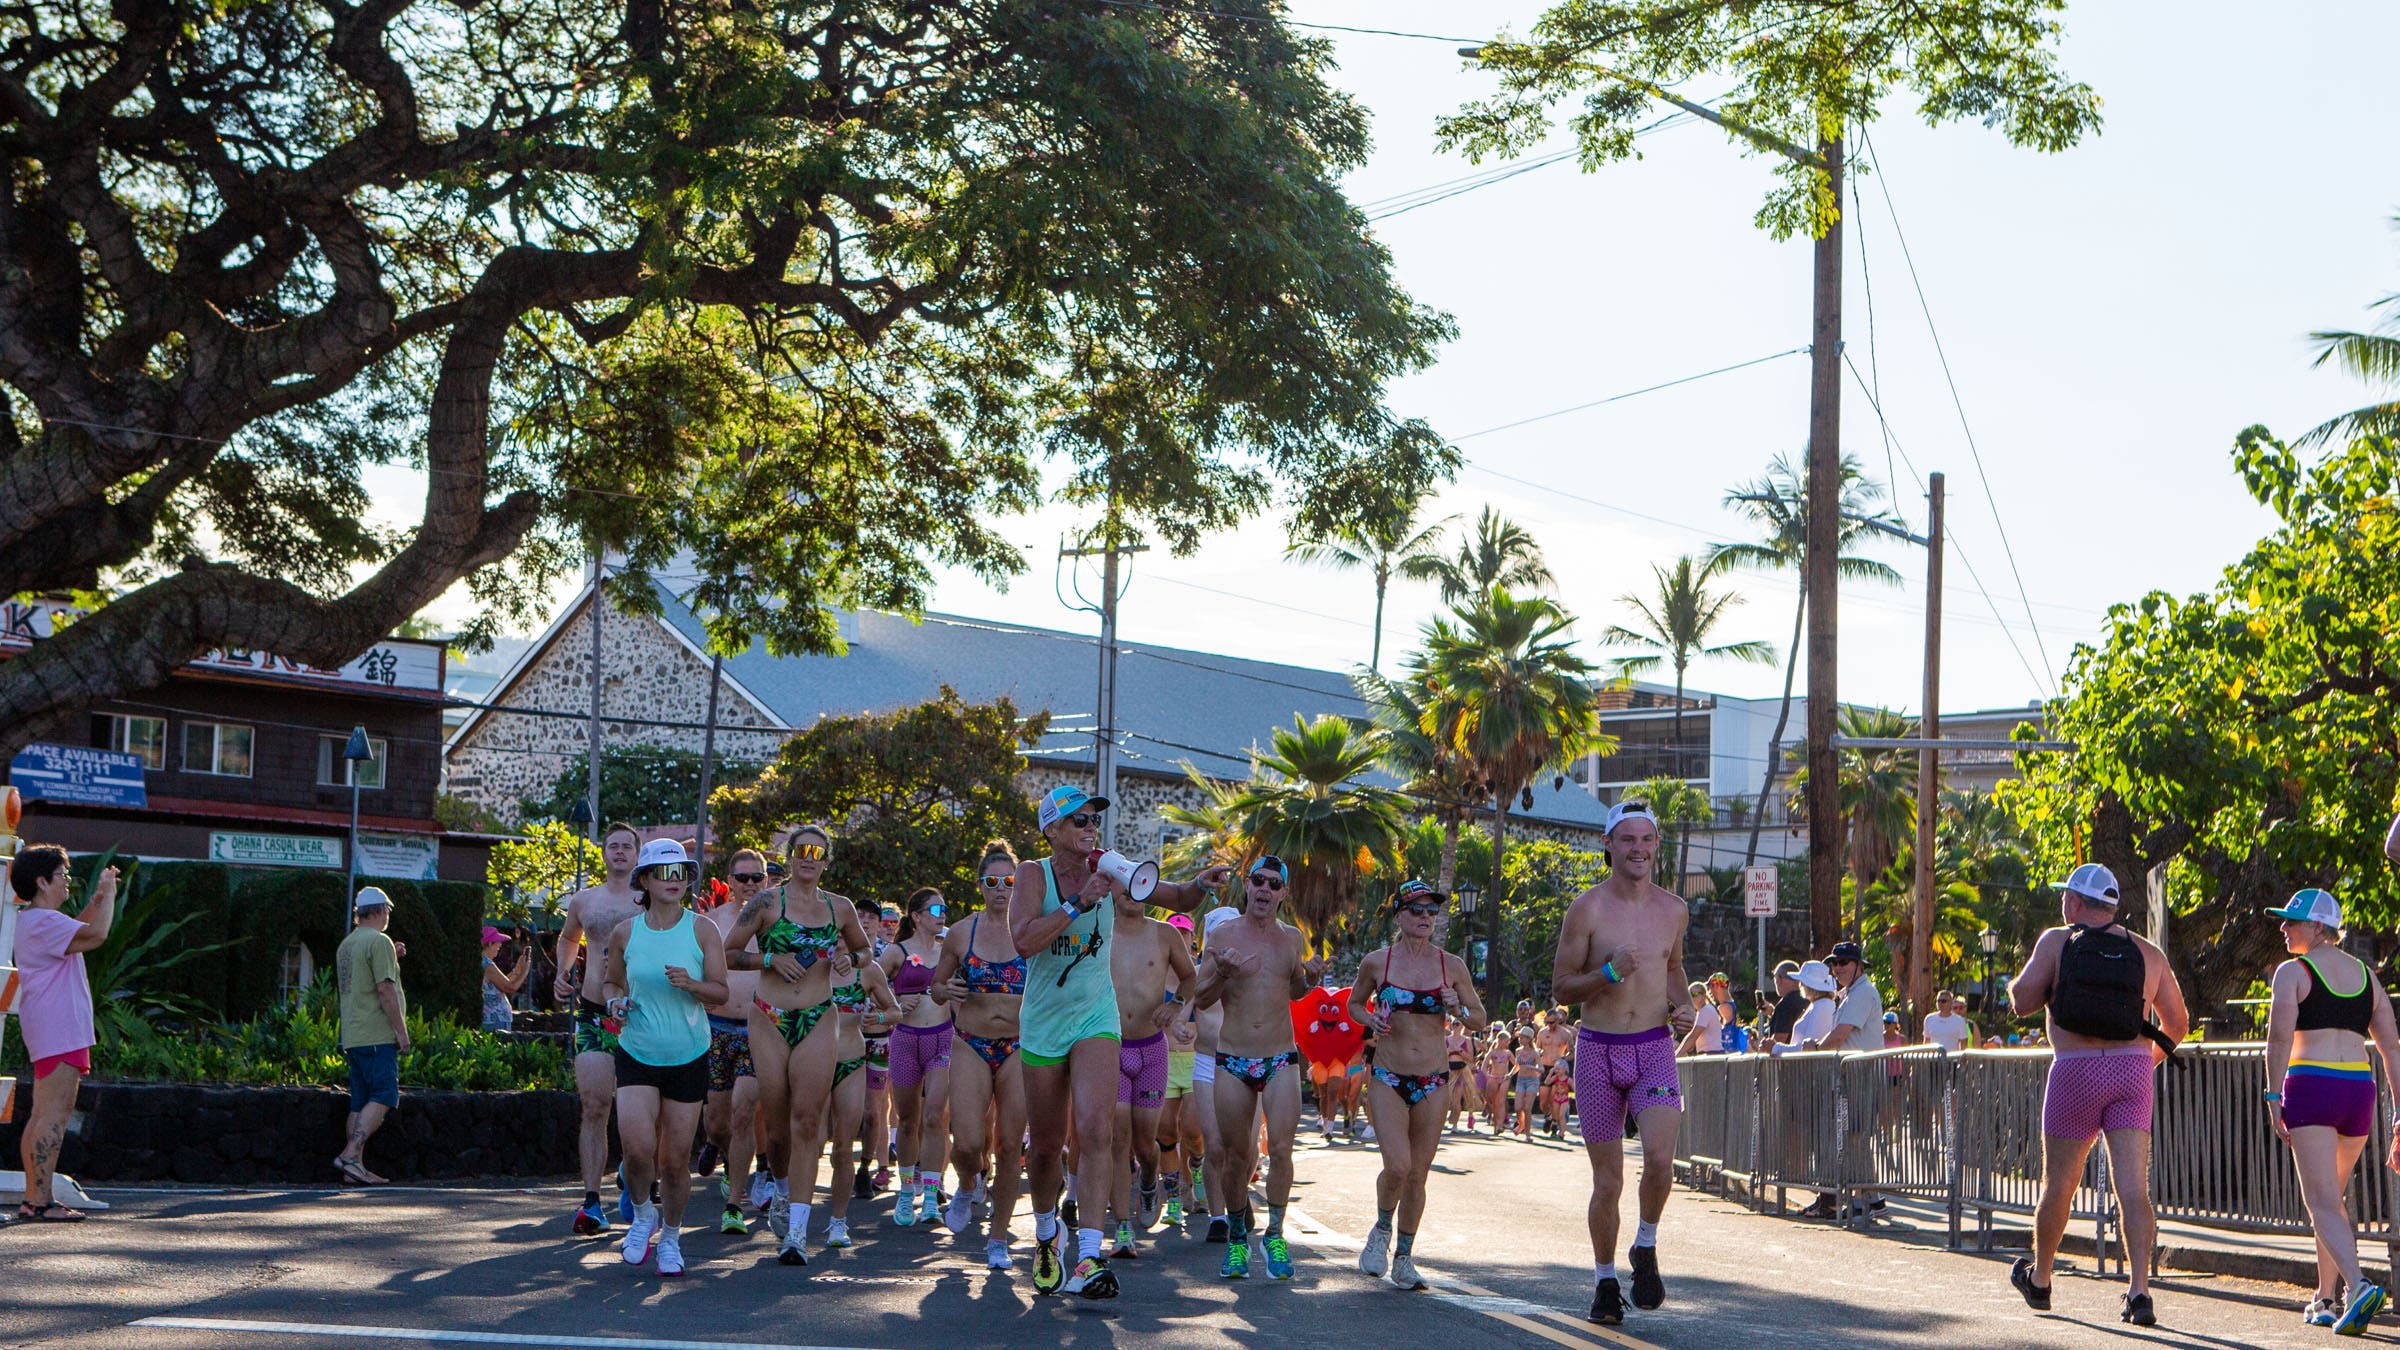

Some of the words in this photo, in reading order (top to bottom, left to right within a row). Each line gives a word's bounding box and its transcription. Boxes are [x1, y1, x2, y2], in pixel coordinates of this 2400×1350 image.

[358, 648, 398, 686] 錦
[63, 748, 137, 768] AVAILABLE
[44, 758, 111, 776] 329-1111
[32, 780, 45, 788] THE
[47, 782, 87, 793] COMMERCIAL
[88, 786, 111, 794] GROUP
[231, 836, 262, 850] OHANA
[264, 838, 296, 852] CASUAL
[1755, 871, 1767, 881] NO
[1747, 882, 1775, 891] PARKING
